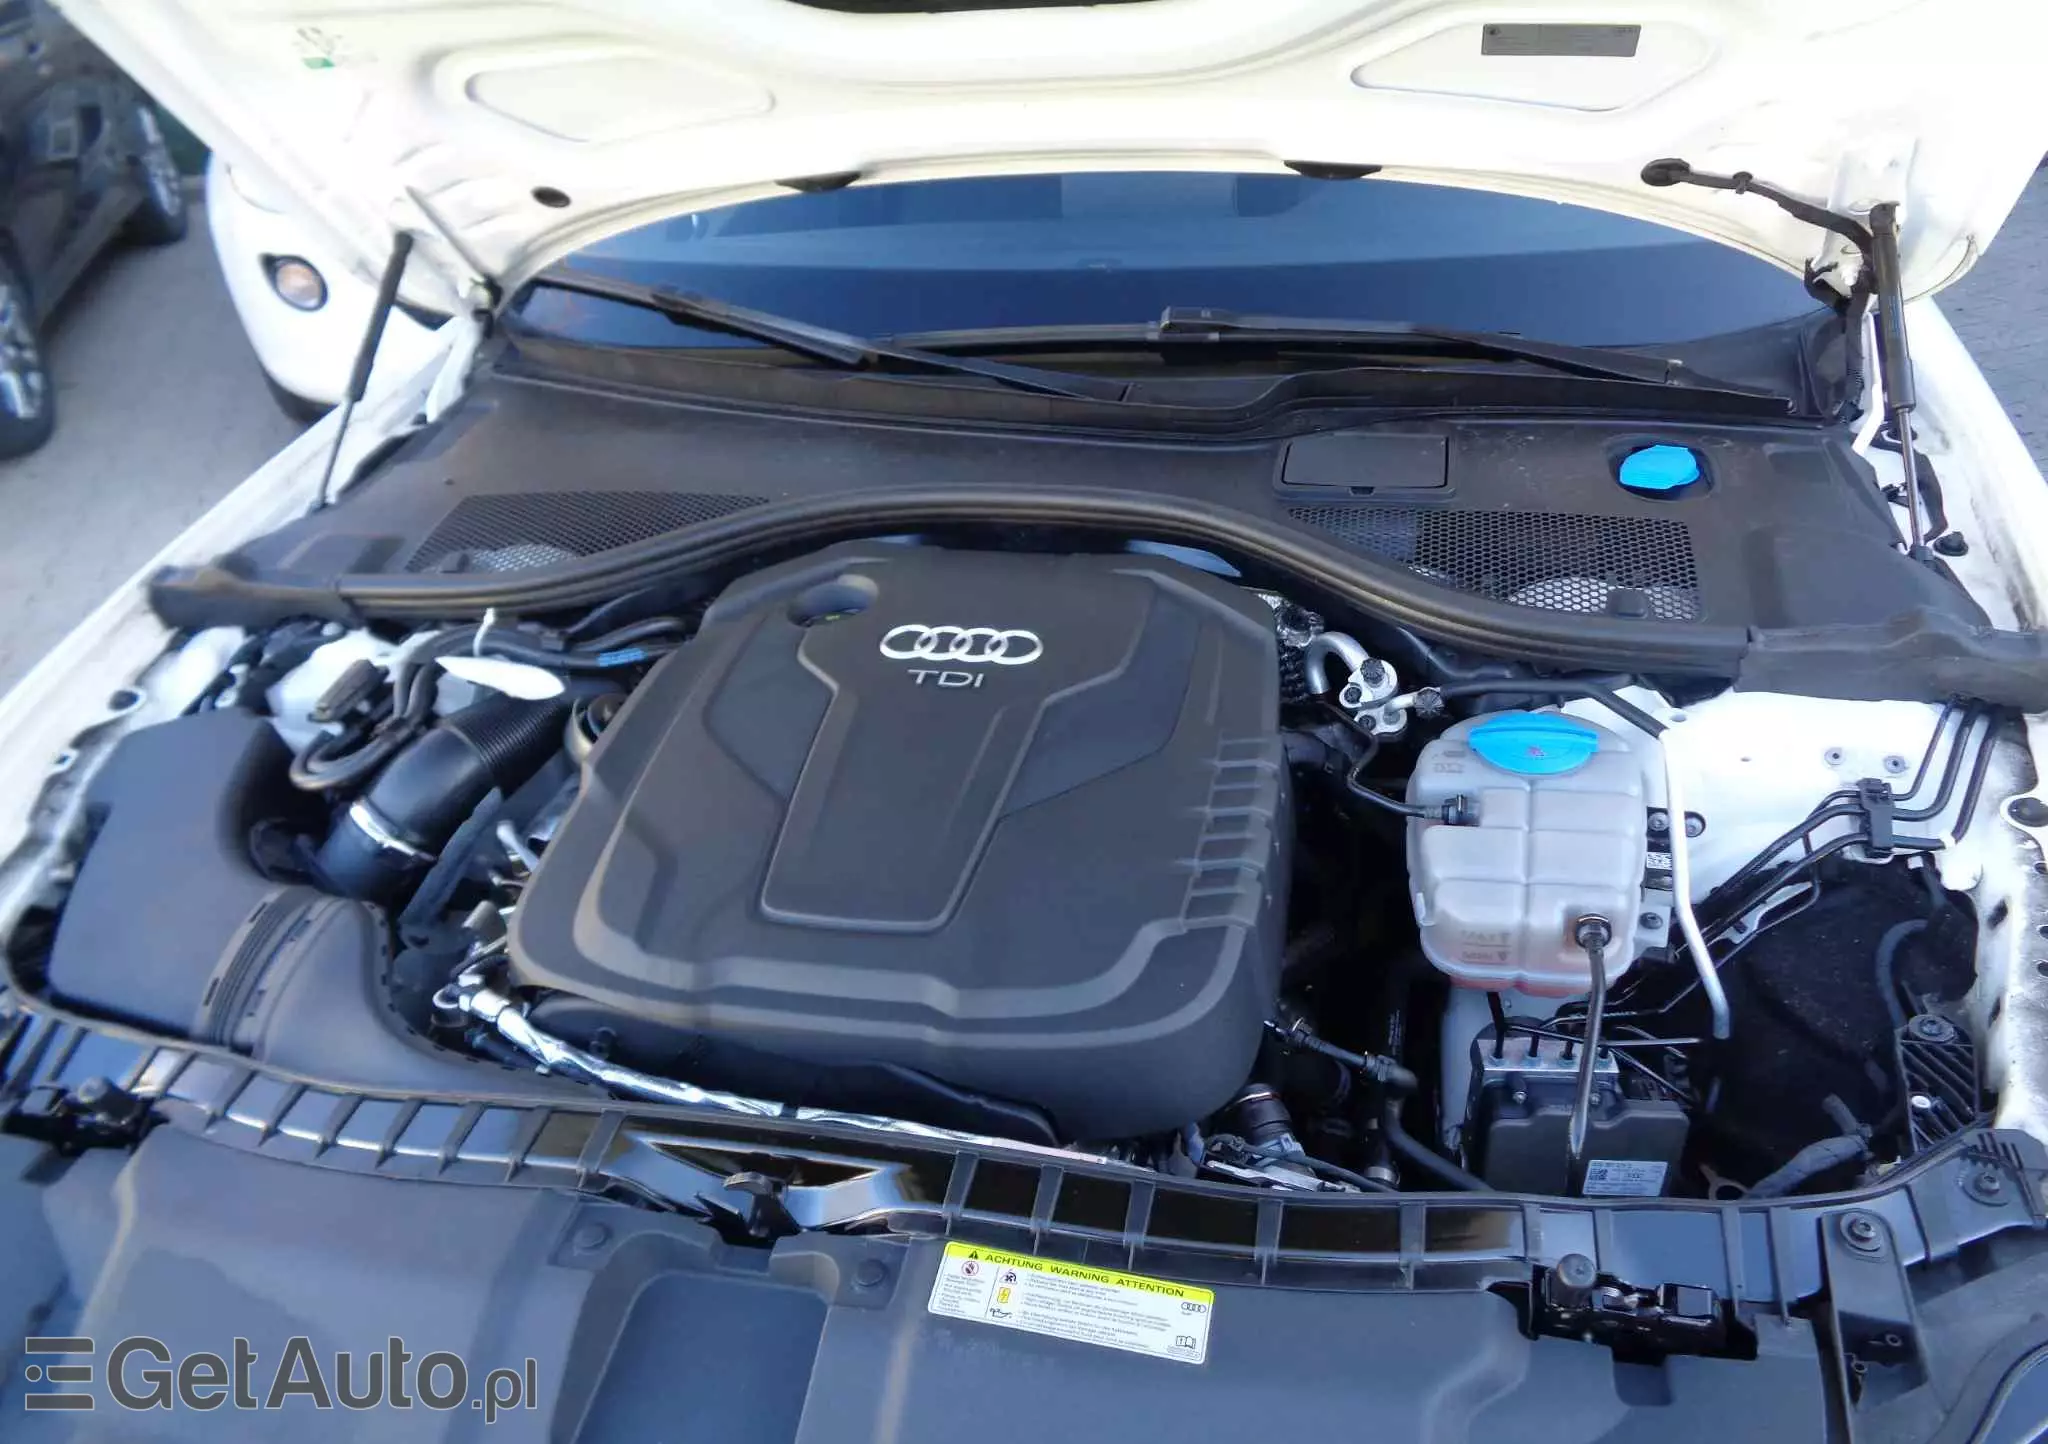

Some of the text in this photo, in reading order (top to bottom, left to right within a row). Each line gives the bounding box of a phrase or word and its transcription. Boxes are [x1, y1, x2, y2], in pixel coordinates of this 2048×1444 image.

[907, 669, 984, 688] TDI
[985, 1254, 1184, 1297] ACHTUNG WARNING ATTENTION
